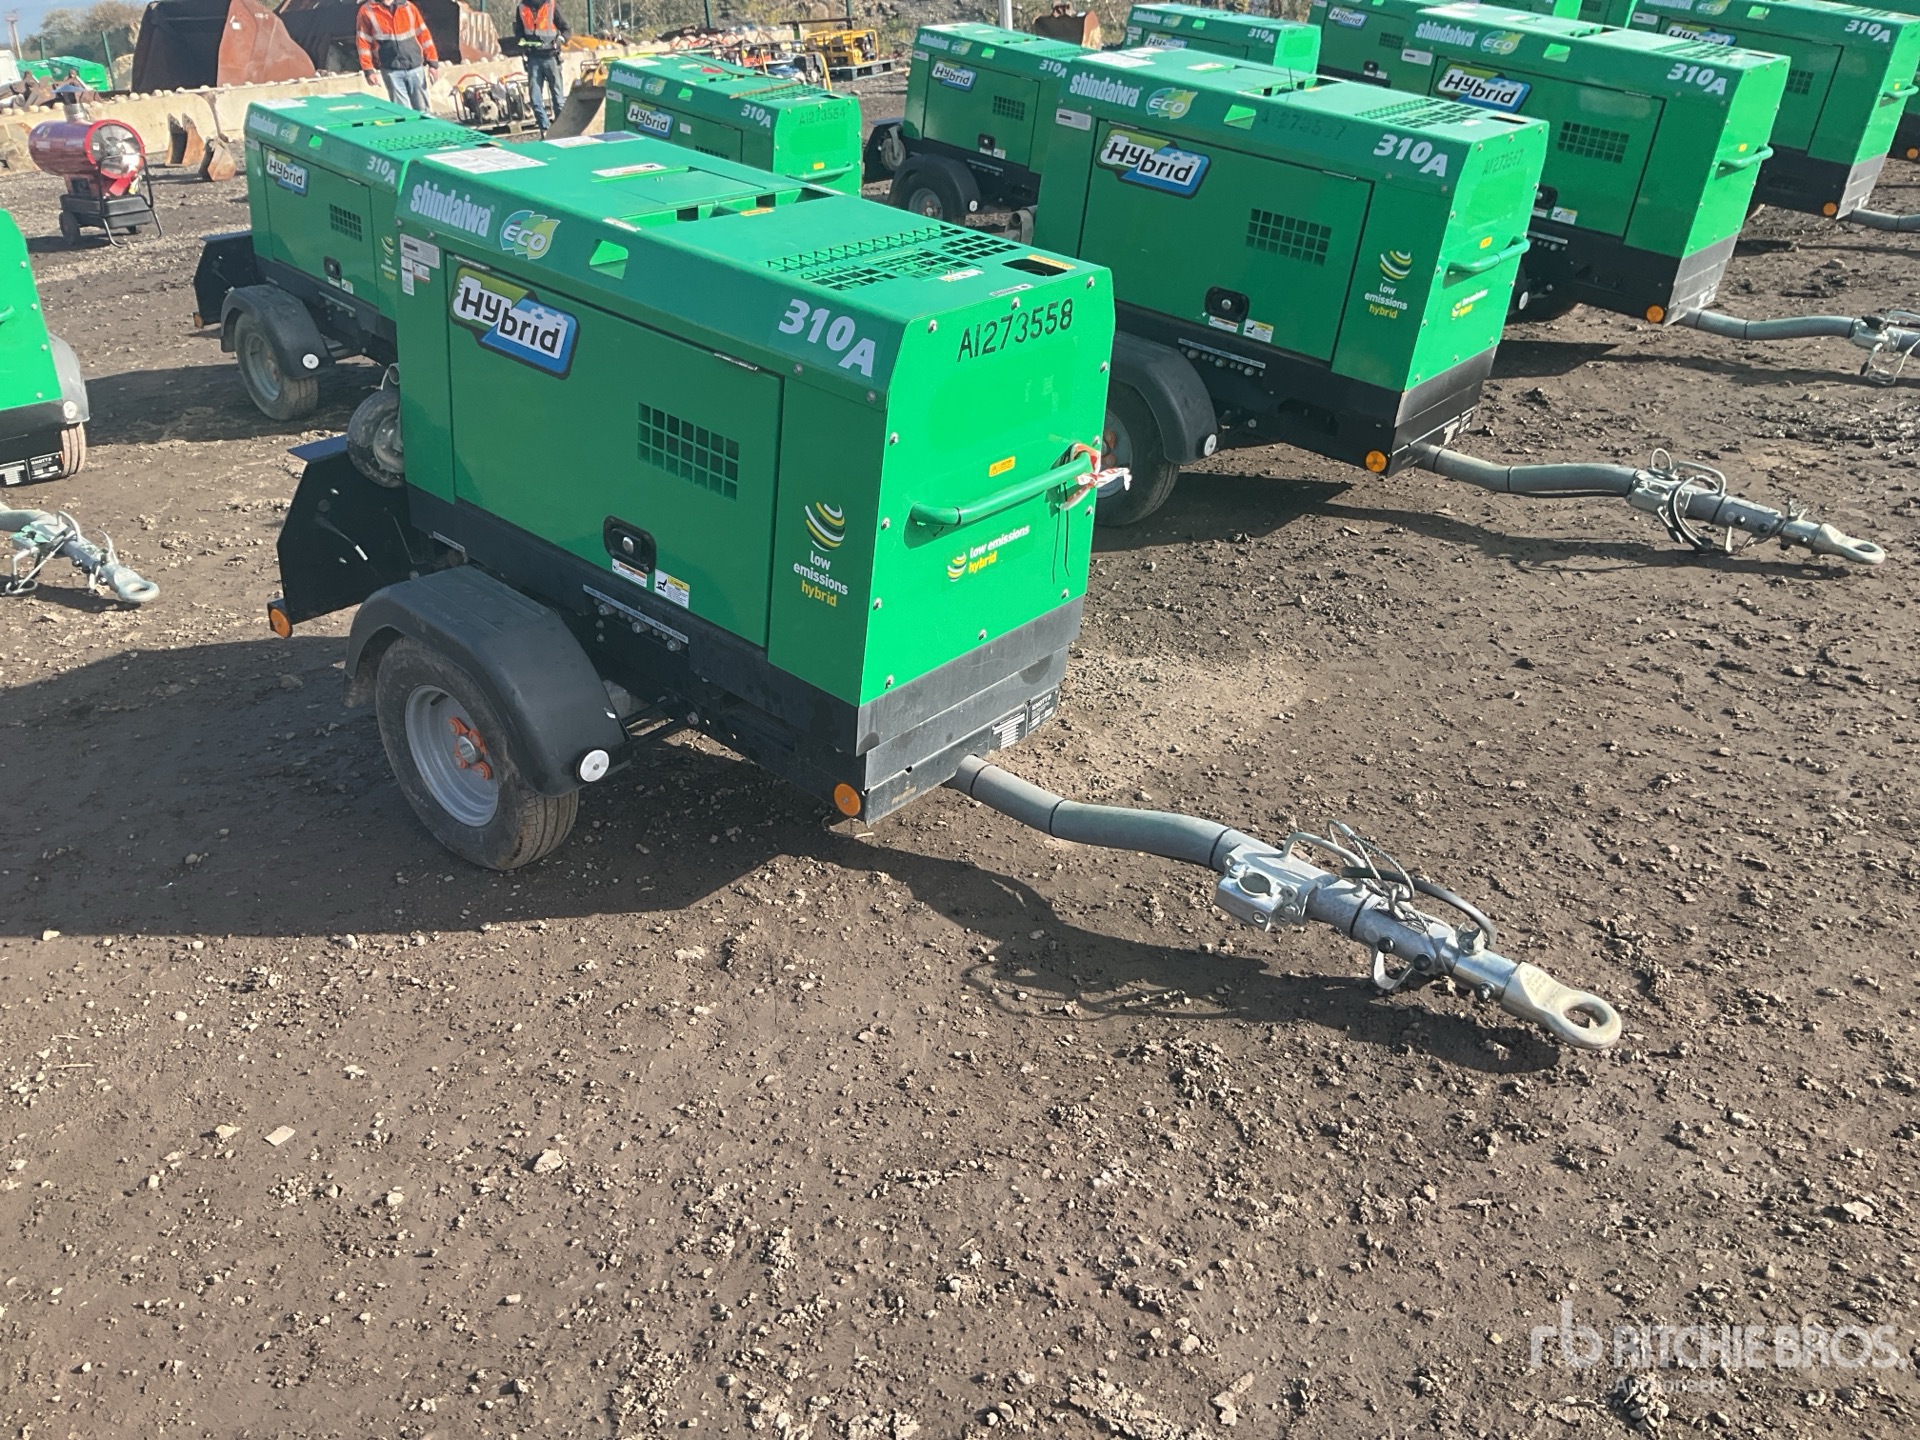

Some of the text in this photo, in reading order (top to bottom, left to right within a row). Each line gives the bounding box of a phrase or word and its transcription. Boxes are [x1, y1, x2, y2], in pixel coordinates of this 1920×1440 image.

[1247, 28, 1275, 44] 310A
[1415, 21, 1475, 47] shindaiwa
[1483, 38, 1514, 50] ECO
[1844, 19, 1891, 43] 310A
[934, 65, 970, 86] Hybrid
[1039, 59, 1067, 78] 310A
[1666, 63, 1728, 96] 310A
[1069, 72, 1140, 108] shindaiwa
[1444, 74, 1516, 104] Hybrid
[630, 106, 667, 131] Hybrid
[740, 104, 771, 128] 310A
[1149, 98, 1186, 114] ECO
[1107, 142, 1193, 183] Hybrid
[1373, 133, 1448, 177] 310A
[269, 158, 303, 186] Hybrid
[366, 155, 397, 185] 310A
[410, 180, 491, 238] shindaiwa
[503, 224, 547, 253] ECO
[1364, 292, 1408, 310] emissions
[1379, 283, 1396, 295] low
[461, 287, 560, 353] Hybrid
[1368, 303, 1398, 319] hybrid
[778, 299, 876, 377] 310A
[969, 525, 1031, 559] low emissions
[810, 550, 831, 571] low
[968, 550, 998, 574] hybrid
[793, 562, 848, 595] emissions
[801, 580, 837, 607] hybrid
